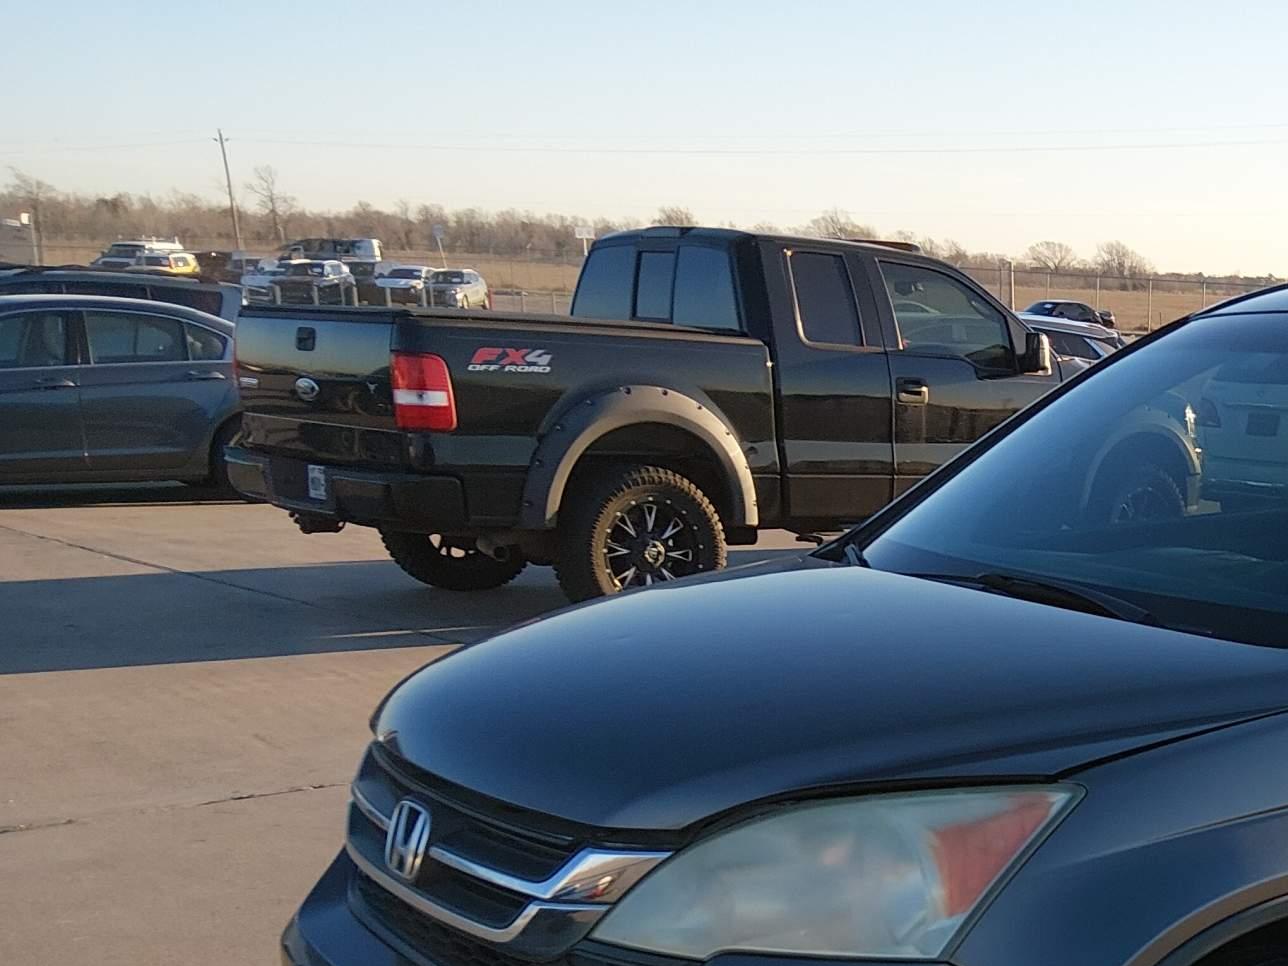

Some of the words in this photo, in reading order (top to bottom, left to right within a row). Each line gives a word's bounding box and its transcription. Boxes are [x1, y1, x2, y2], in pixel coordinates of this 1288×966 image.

[472, 347, 553, 366] FX4
[467, 364, 500, 372] OFF
[504, 365, 552, 374] ROAD
